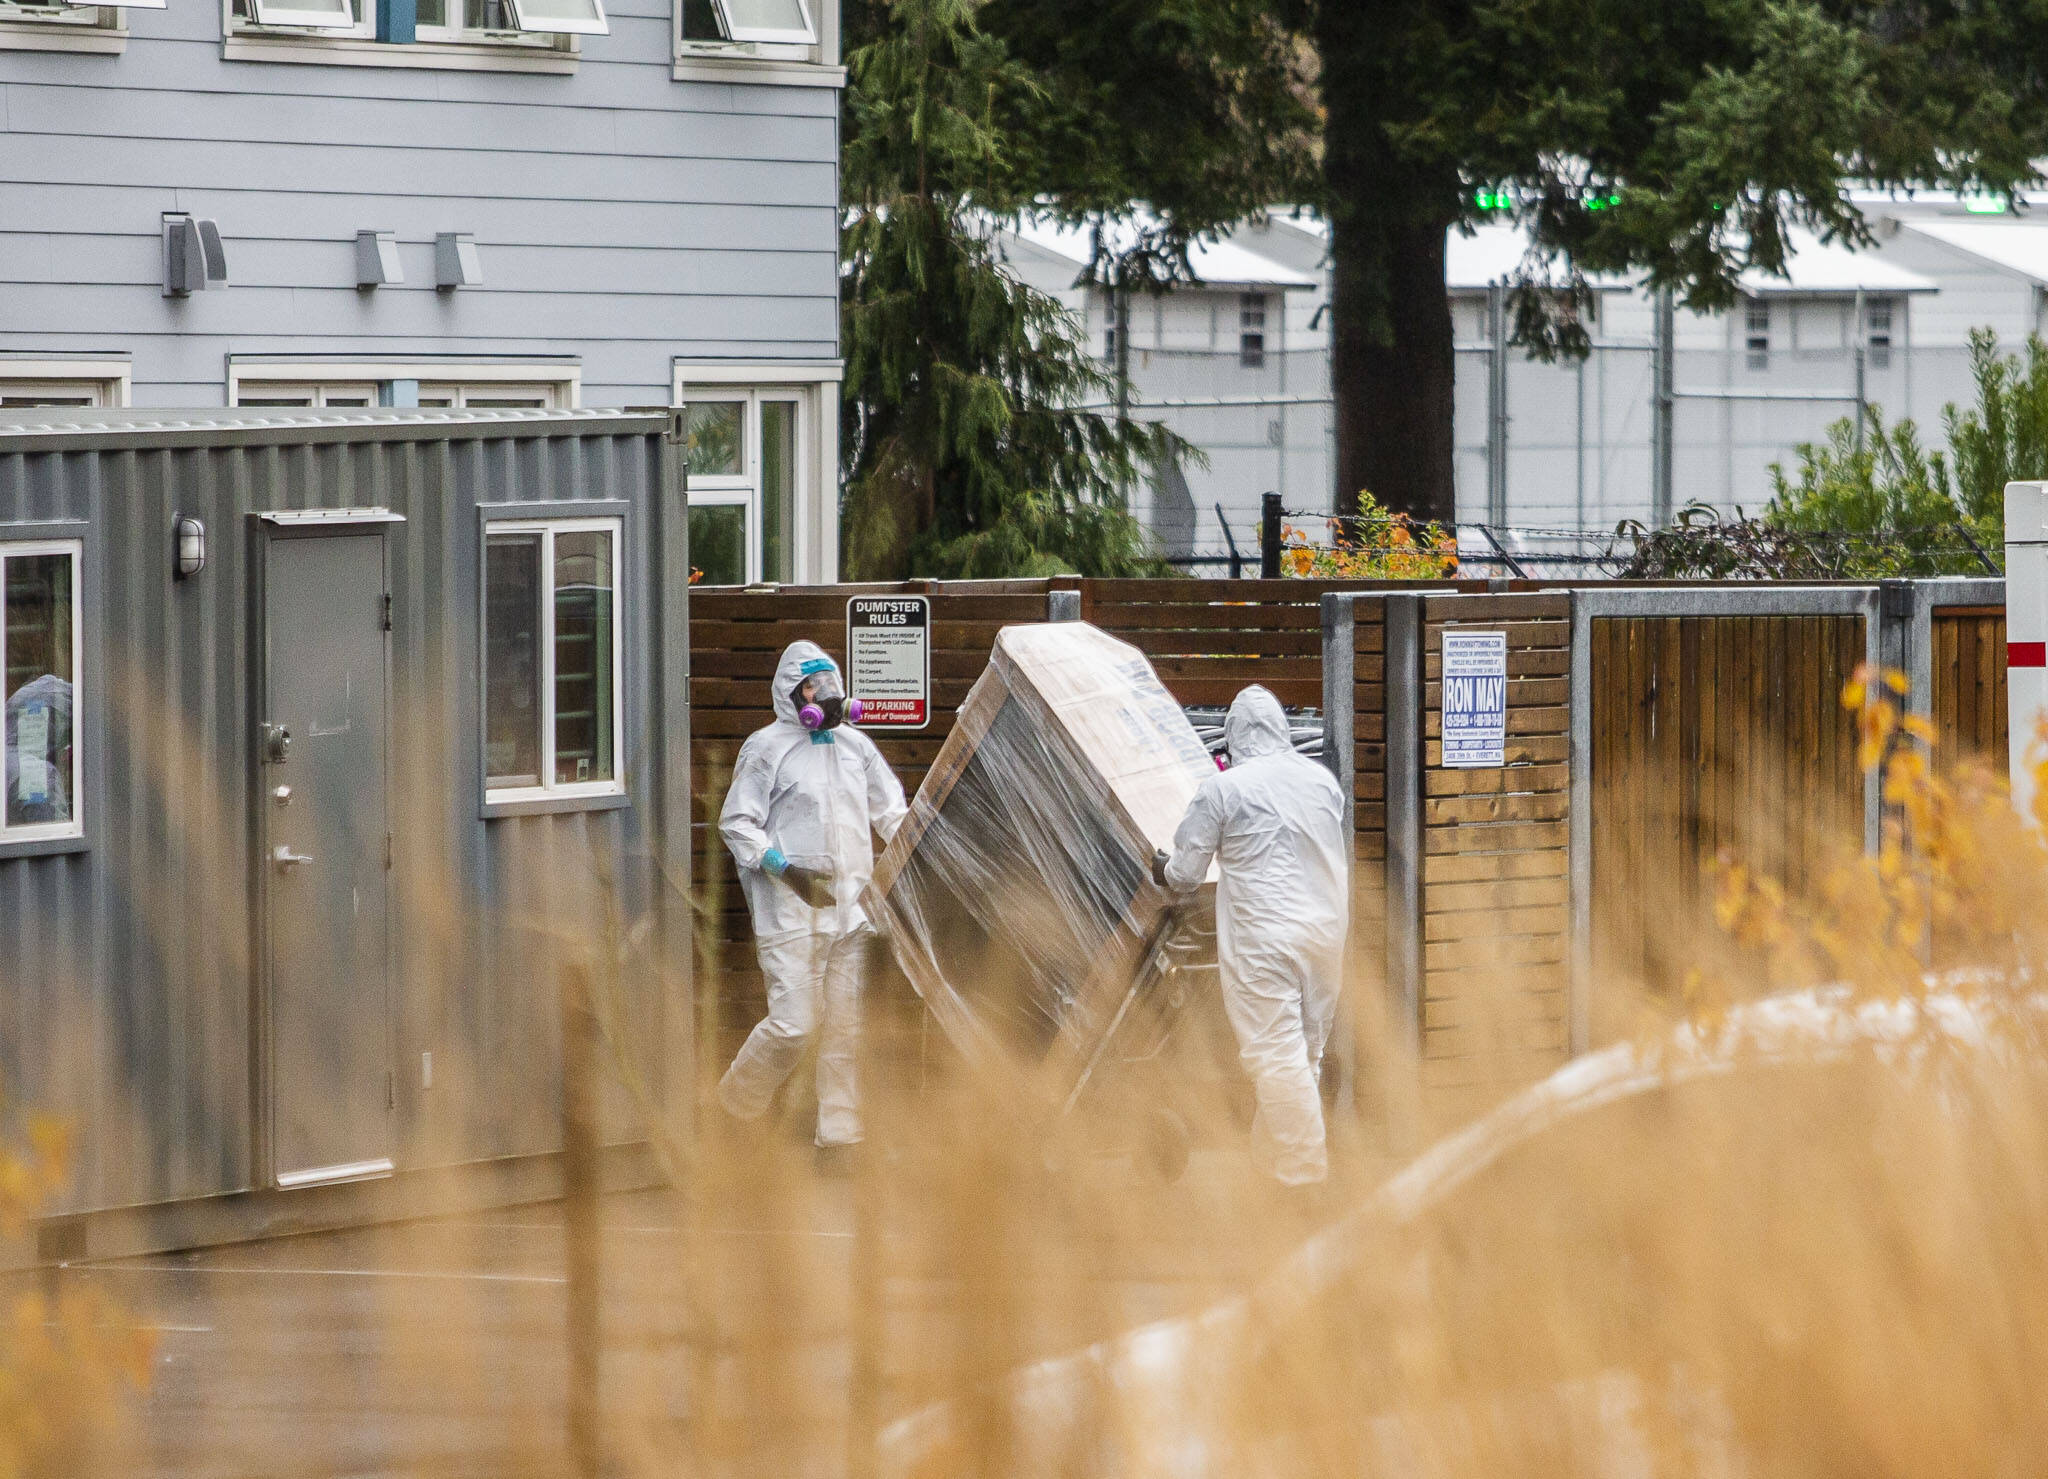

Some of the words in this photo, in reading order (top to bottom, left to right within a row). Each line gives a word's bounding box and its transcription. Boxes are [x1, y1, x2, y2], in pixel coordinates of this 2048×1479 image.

[856, 602, 920, 613] DUMPSTER
[869, 614, 907, 625] RULES
[1446, 677, 1473, 713] RON
[1476, 677, 1503, 712] MAY
[862, 701, 875, 711] NO
[876, 701, 915, 711] PARKING
[864, 713, 881, 721] Front
[881, 713, 889, 721] of
[889, 713, 920, 721] Dumpster
